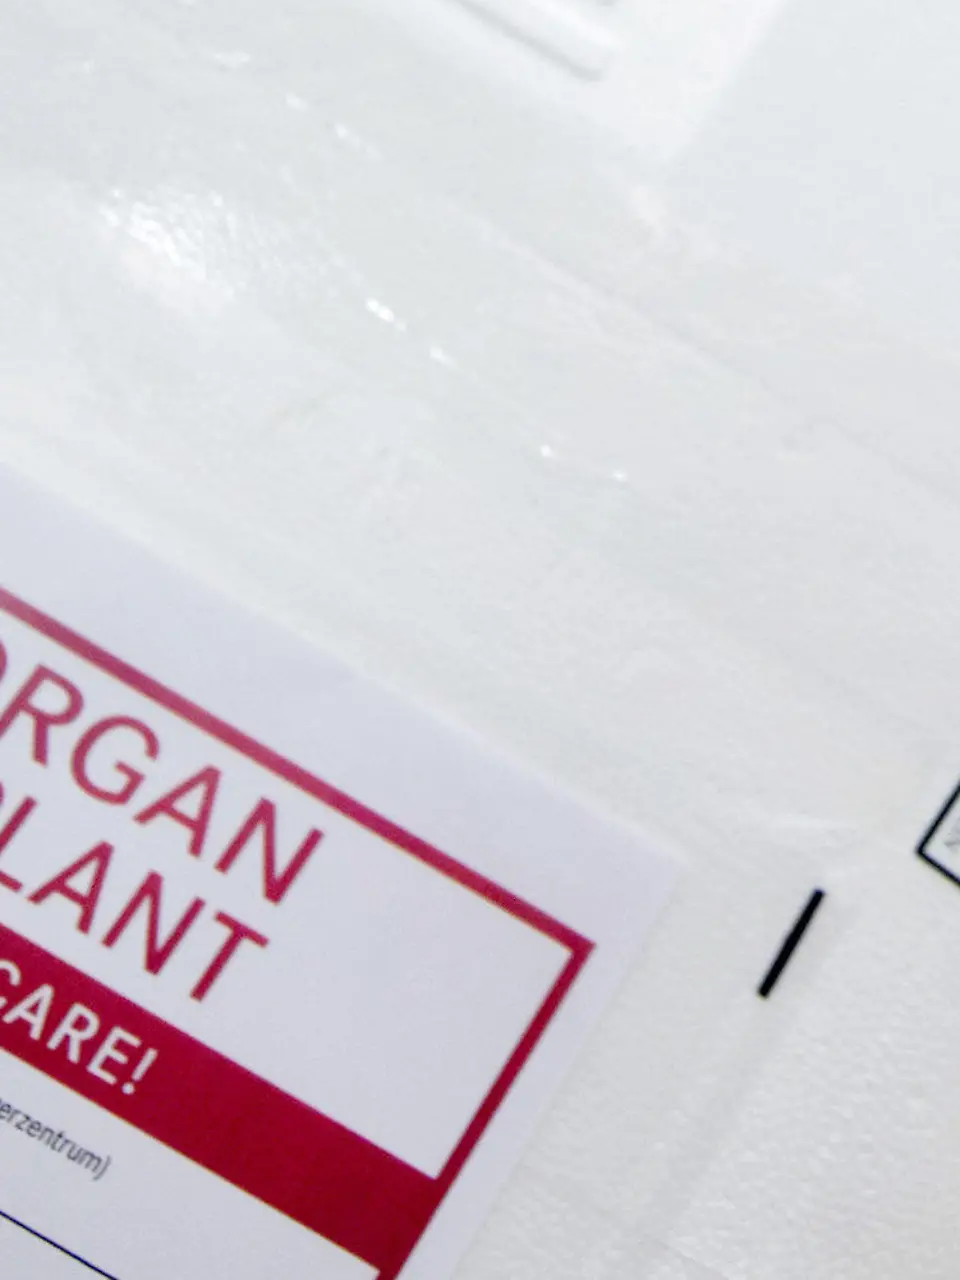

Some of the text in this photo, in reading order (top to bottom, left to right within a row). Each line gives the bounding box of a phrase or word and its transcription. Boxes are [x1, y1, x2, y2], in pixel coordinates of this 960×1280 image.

[0, 639, 325, 906] RGAN
[0, 781, 269, 1003] LANT
[0, 1096, 112, 1181] erzentrum)
